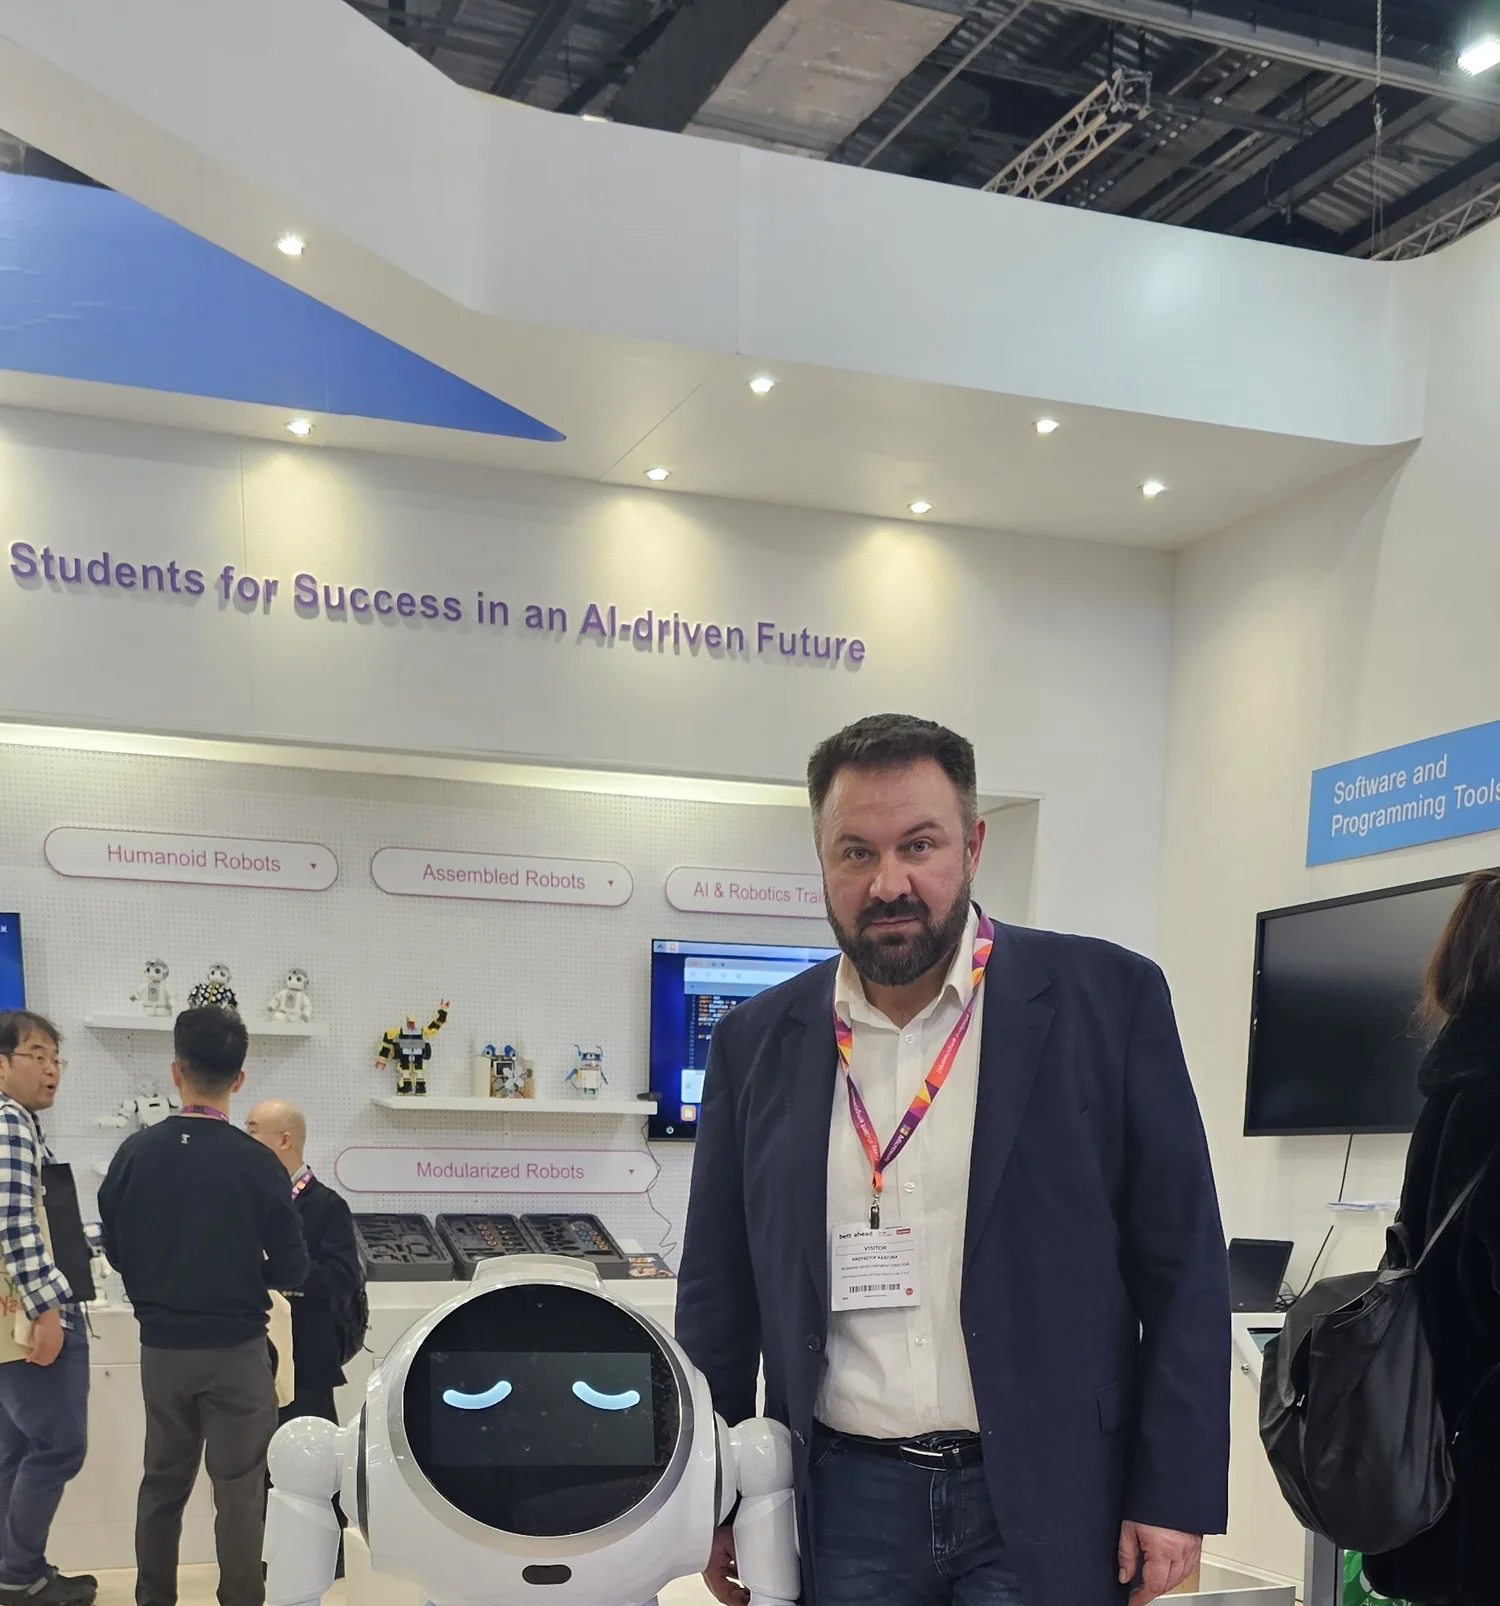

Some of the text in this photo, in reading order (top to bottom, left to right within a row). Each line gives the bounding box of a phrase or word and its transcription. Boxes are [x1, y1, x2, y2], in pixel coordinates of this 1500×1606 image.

[10, 541, 866, 663] Students for Success in an AI-driven Future
[1333, 753, 1448, 805] Software and
[1331, 777, 1500, 838] Programming Tools
[107, 844, 281, 873] Humanoid Robots
[422, 863, 586, 890] Assembled Robots
[694, 881, 824, 904] AI & Robotics Trai
[417, 1162, 584, 1180] Modularized Robots
